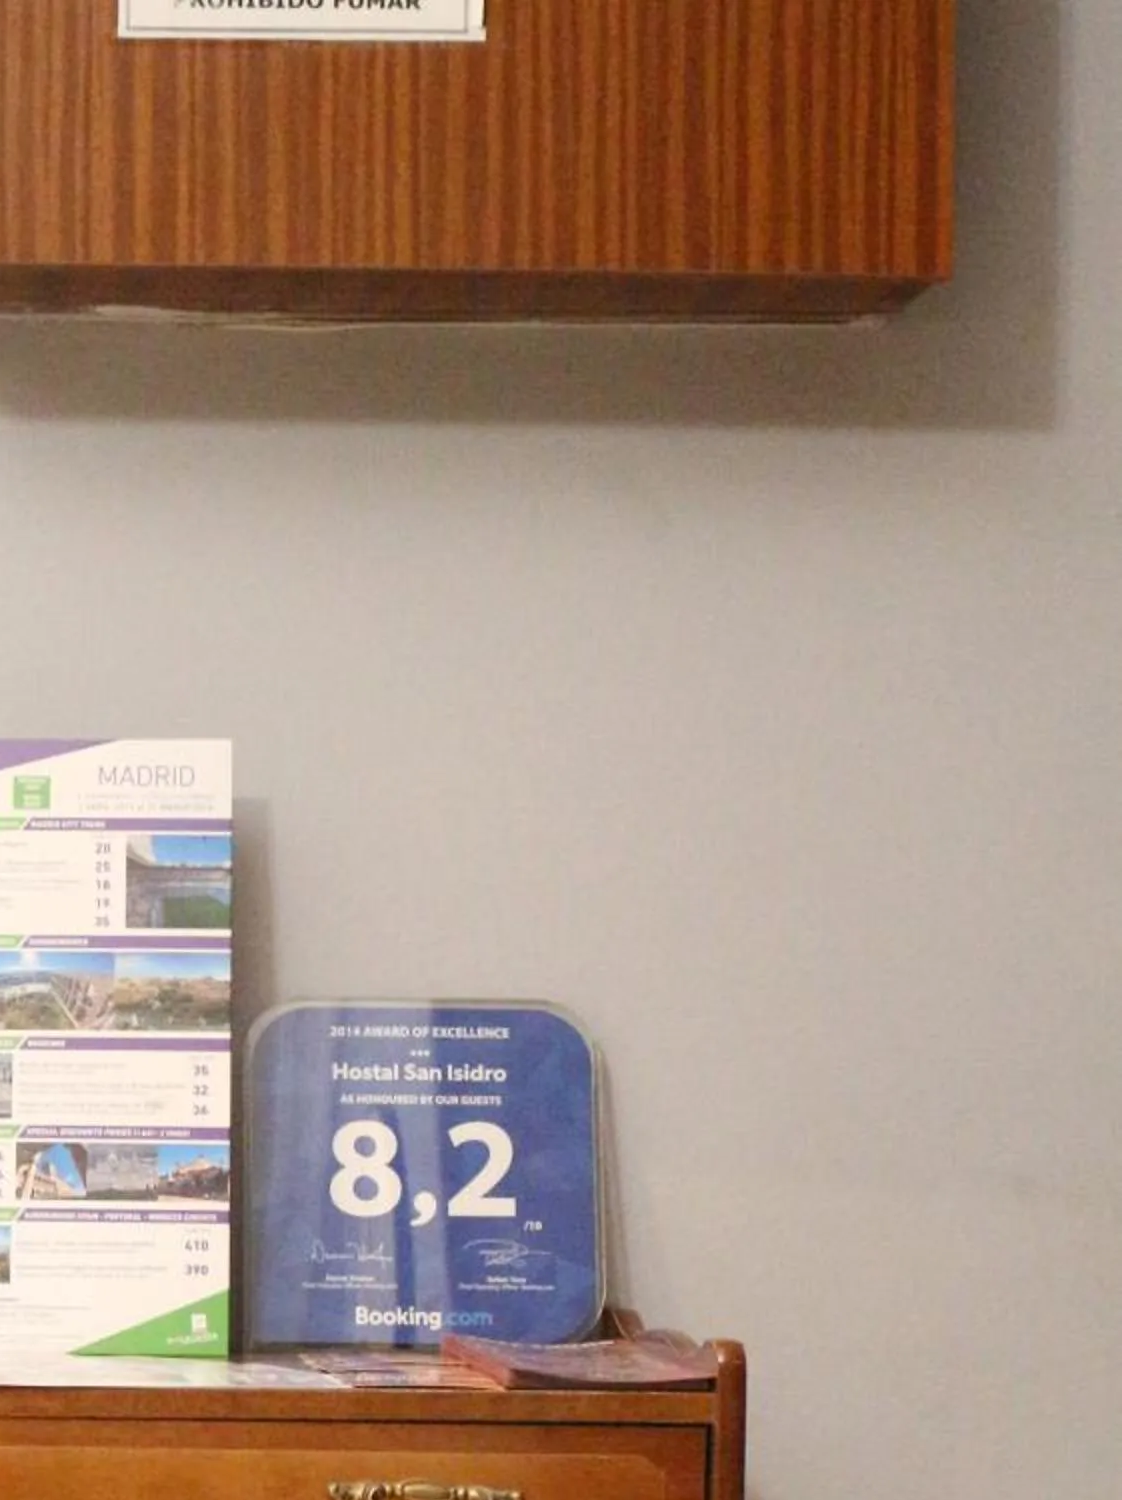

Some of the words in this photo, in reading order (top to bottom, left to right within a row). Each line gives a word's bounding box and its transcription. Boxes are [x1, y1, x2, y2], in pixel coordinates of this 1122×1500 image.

[334, 0, 420, 9] FUMAR
[98, 765, 195, 787] MADRID
[363, 1026, 409, 1038] AWARD
[411, 1026, 429, 1038] OF
[432, 1027, 510, 1039] EXCELLENCE
[332, 1062, 399, 1081] Hostal
[404, 1063, 443, 1082] San
[448, 1063, 507, 1082] Isidro
[340, 1094, 355, 1105] AS
[420, 1095, 433, 1106] BY
[436, 1095, 459, 1106] OUR
[461, 1095, 502, 1107] GUESTS
[328, 1119, 517, 1228] 8,2
[355, 1305, 494, 1331] Booking.com
